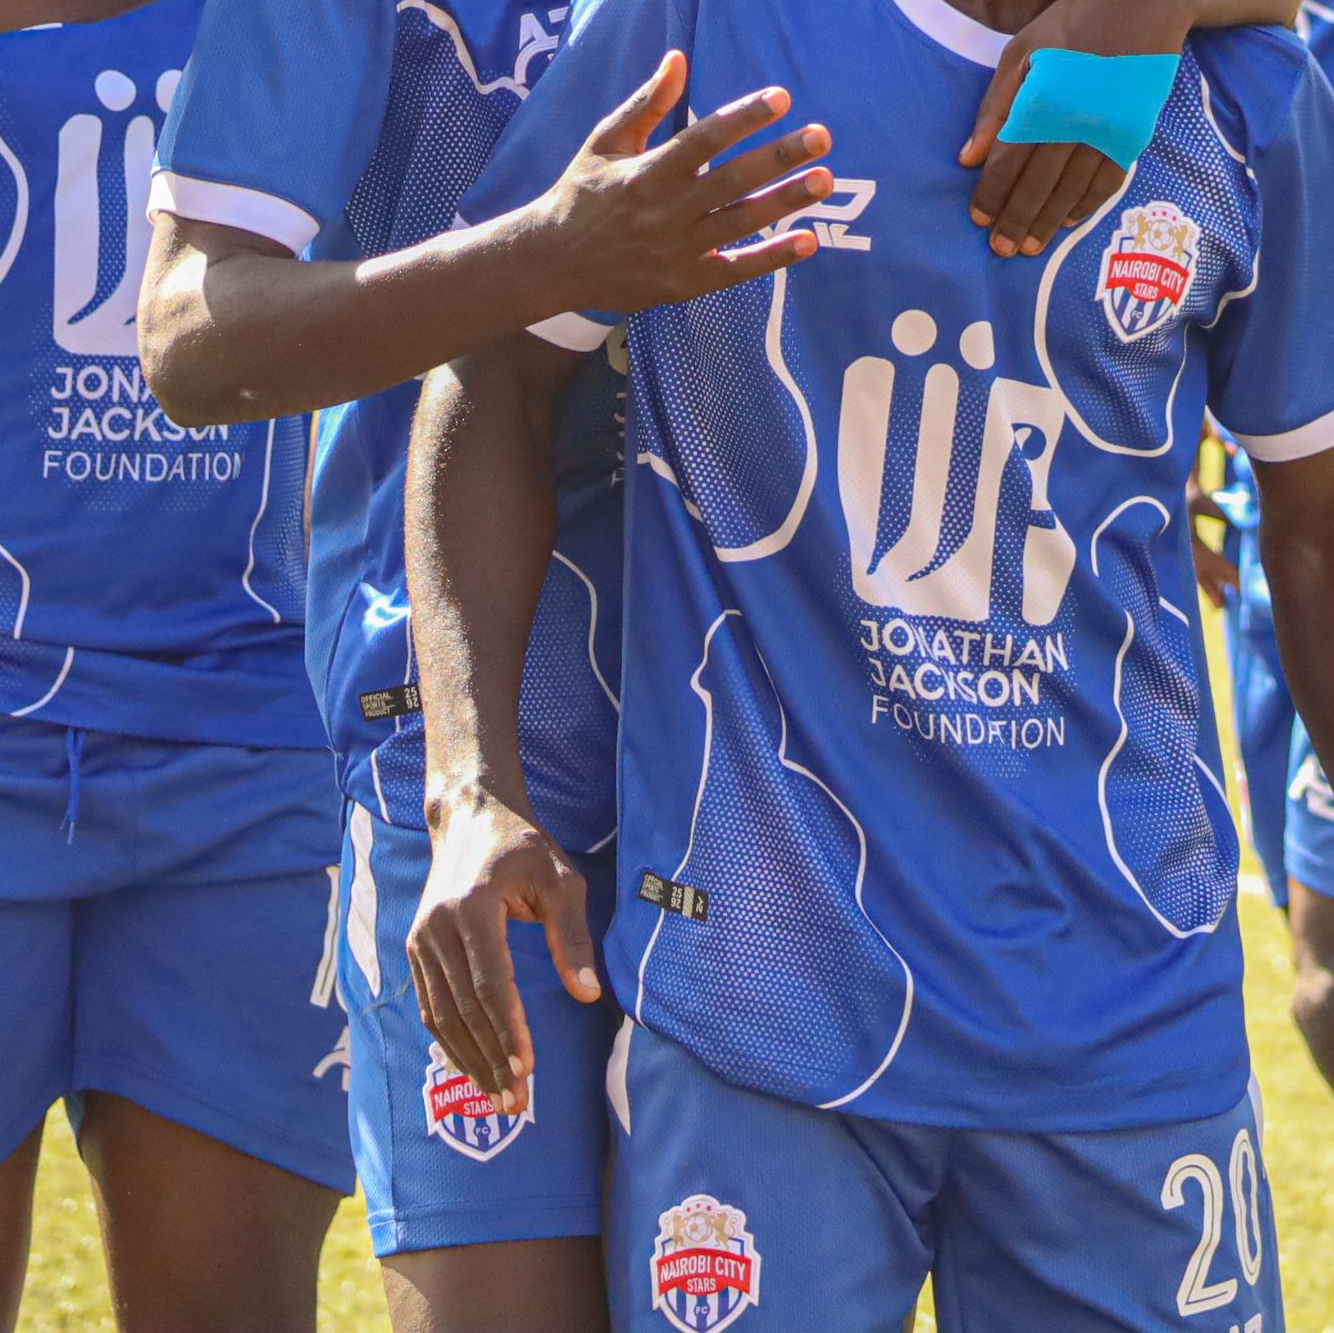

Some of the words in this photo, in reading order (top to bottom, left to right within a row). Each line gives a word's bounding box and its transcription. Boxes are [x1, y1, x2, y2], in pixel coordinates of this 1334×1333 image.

[1111, 260, 1162, 282] NAIROBI
[1161, 268, 1184, 293] CITY
[1133, 283, 1159, 299] STARS
[1131, 310, 1143, 319] FC
[42, 450, 245, 481] FOUNDATION
[859, 617, 1070, 674] JONATHAN
[404, 686, 418, 698] 25
[867, 657, 1041, 707] JACKSON
[871, 694, 1065, 749] FOUNDATION
[671, 885, 683, 899] 25
[434, 1081, 487, 1110] NAIRO
[463, 1099, 494, 1115] STARS
[475, 1127, 489, 1135] FC
[1160, 1128, 1262, 1317] 20
[660, 1254, 711, 1284] NAIROBI
[715, 1256, 746, 1281] CITY
[686, 1277, 717, 1293] STARS
[695, 1306, 708, 1315] FC
